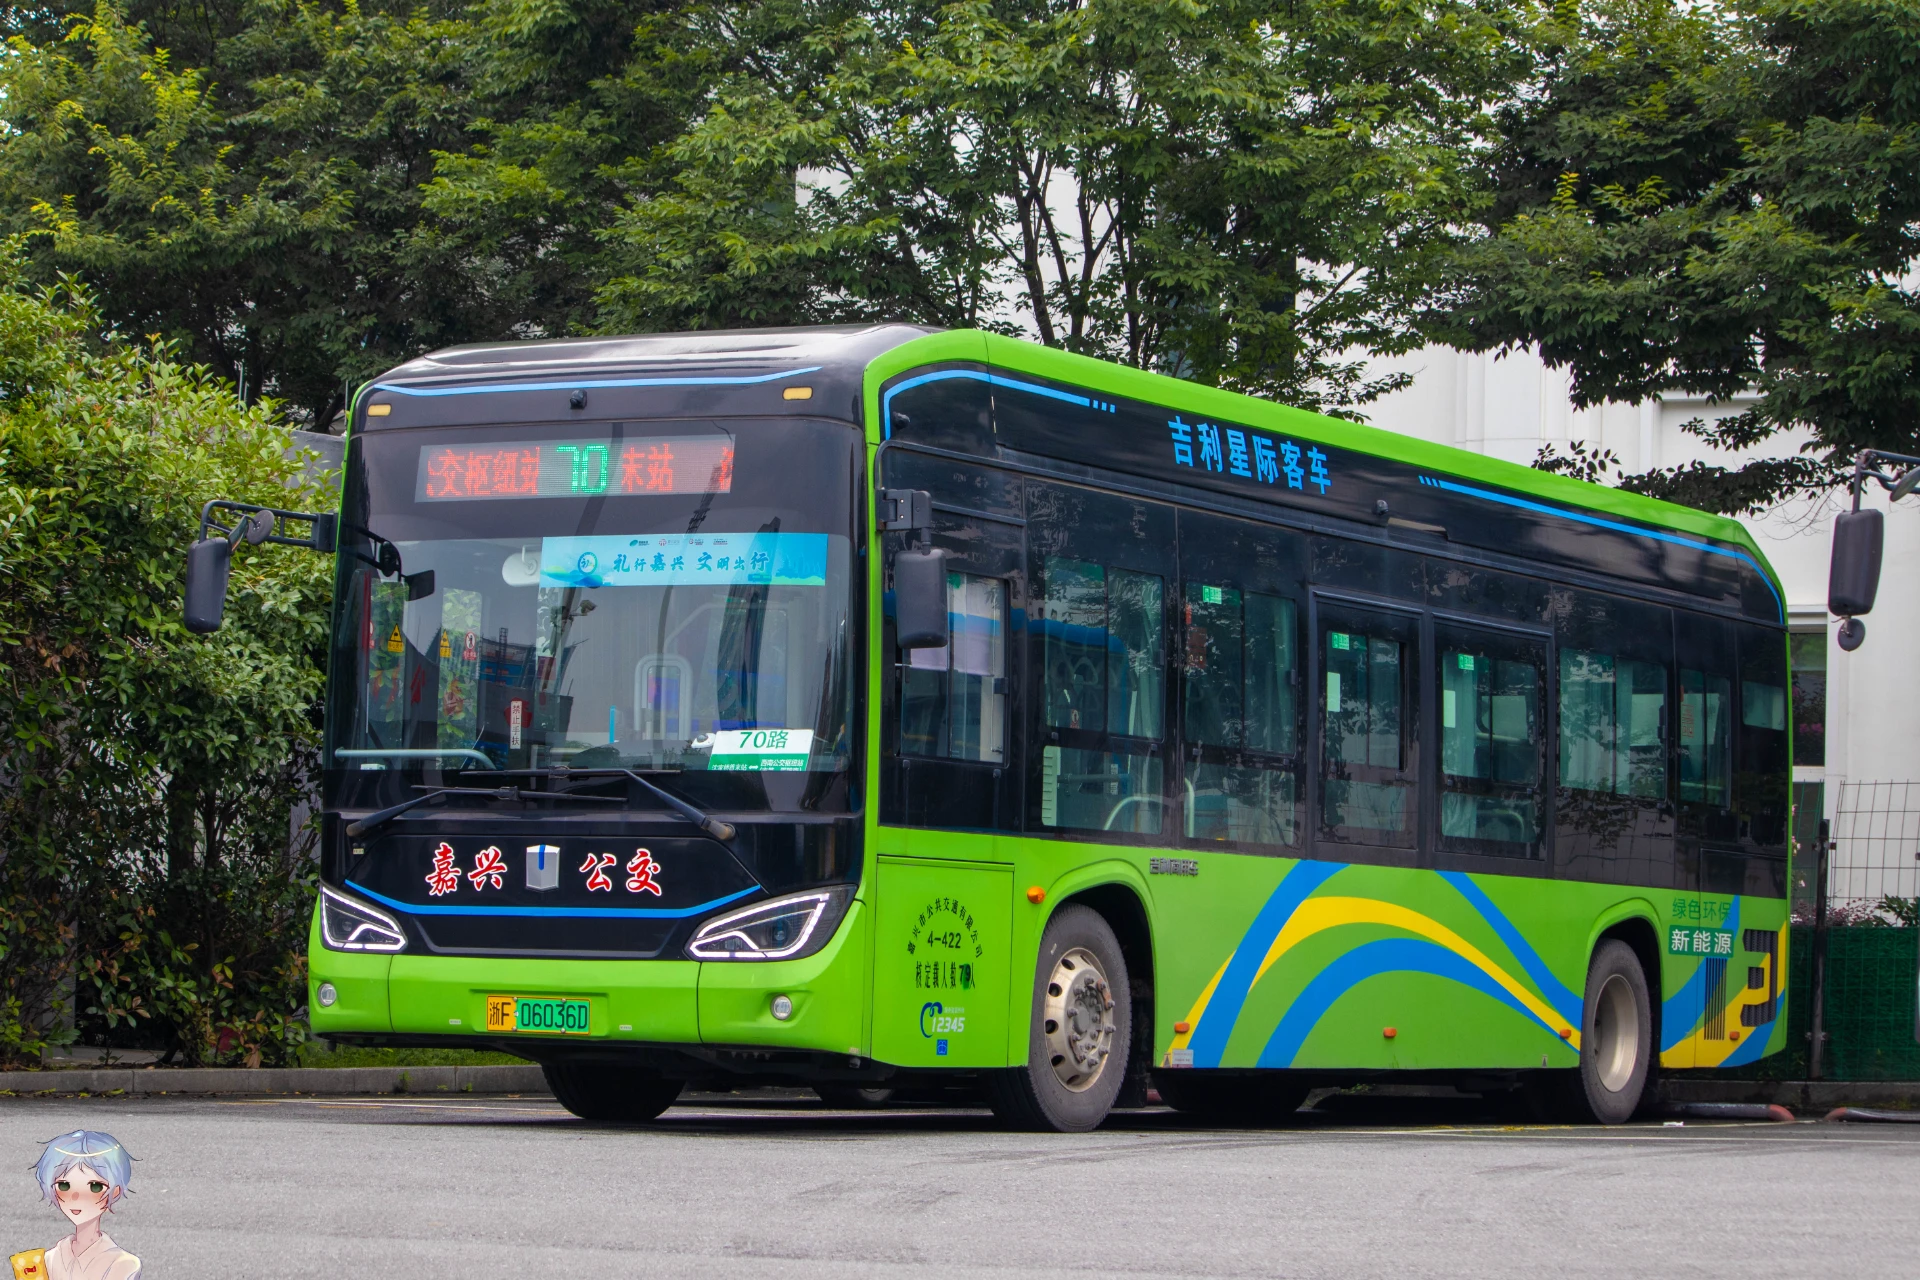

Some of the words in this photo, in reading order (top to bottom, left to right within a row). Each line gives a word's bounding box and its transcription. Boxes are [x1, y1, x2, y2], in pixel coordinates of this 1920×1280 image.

[556, 444, 609, 494] 70
[621, 443, 674, 492] 末站
[1168, 414, 1332, 495] 吉利星际客车
[613, 552, 684, 573] 礼行嘉兴
[696, 551, 769, 572] 文明出行
[511, 704, 521, 747] 禁止手扶
[739, 730, 789, 749] 70路
[425, 843, 507, 896] 嘉兴
[579, 849, 662, 896] 公交
[1672, 897, 1732, 921] 绿色环保
[907, 897, 983, 958] 嘉兴市公共交通有限公司
[927, 930, 961, 949] 4-422
[1671, 929, 1732, 954] 新能源
[931, 1017, 966, 1033] 12345
